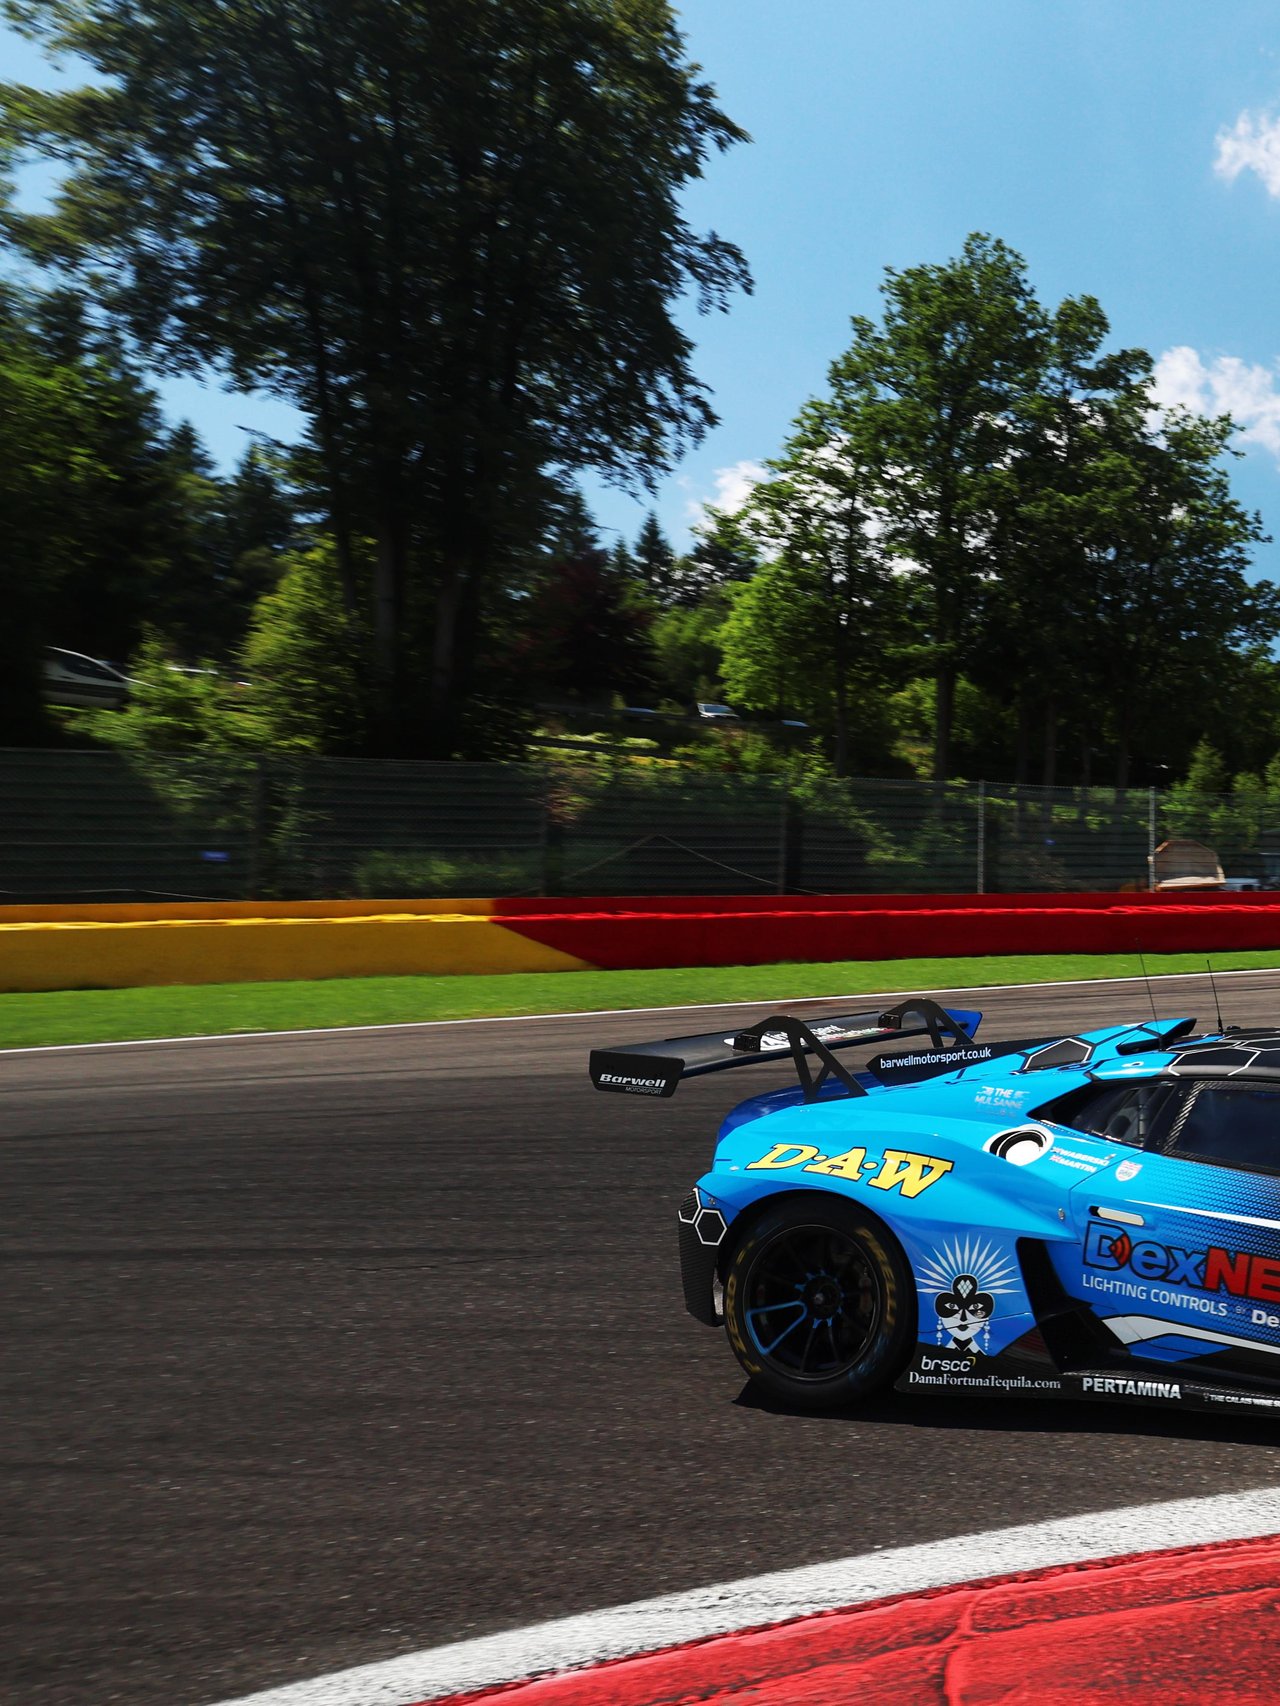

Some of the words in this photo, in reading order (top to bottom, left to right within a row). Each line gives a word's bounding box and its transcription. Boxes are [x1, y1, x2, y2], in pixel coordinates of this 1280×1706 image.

[880, 1046, 992, 1070] barwellmotorsport.co.uk
[599, 1073, 667, 1088] Barwell
[994, 1087, 1014, 1098] THE
[1081, 1273, 1148, 1300] LIGHTING
[1150, 1288, 1229, 1318] CONTROLS
[920, 1355, 972, 1372] brscc
[908, 1371, 1062, 1391] DamaFortunaTequila.com
[1082, 1377, 1182, 1400] PERTAMINA
[1209, 1393, 1226, 1403] THE
